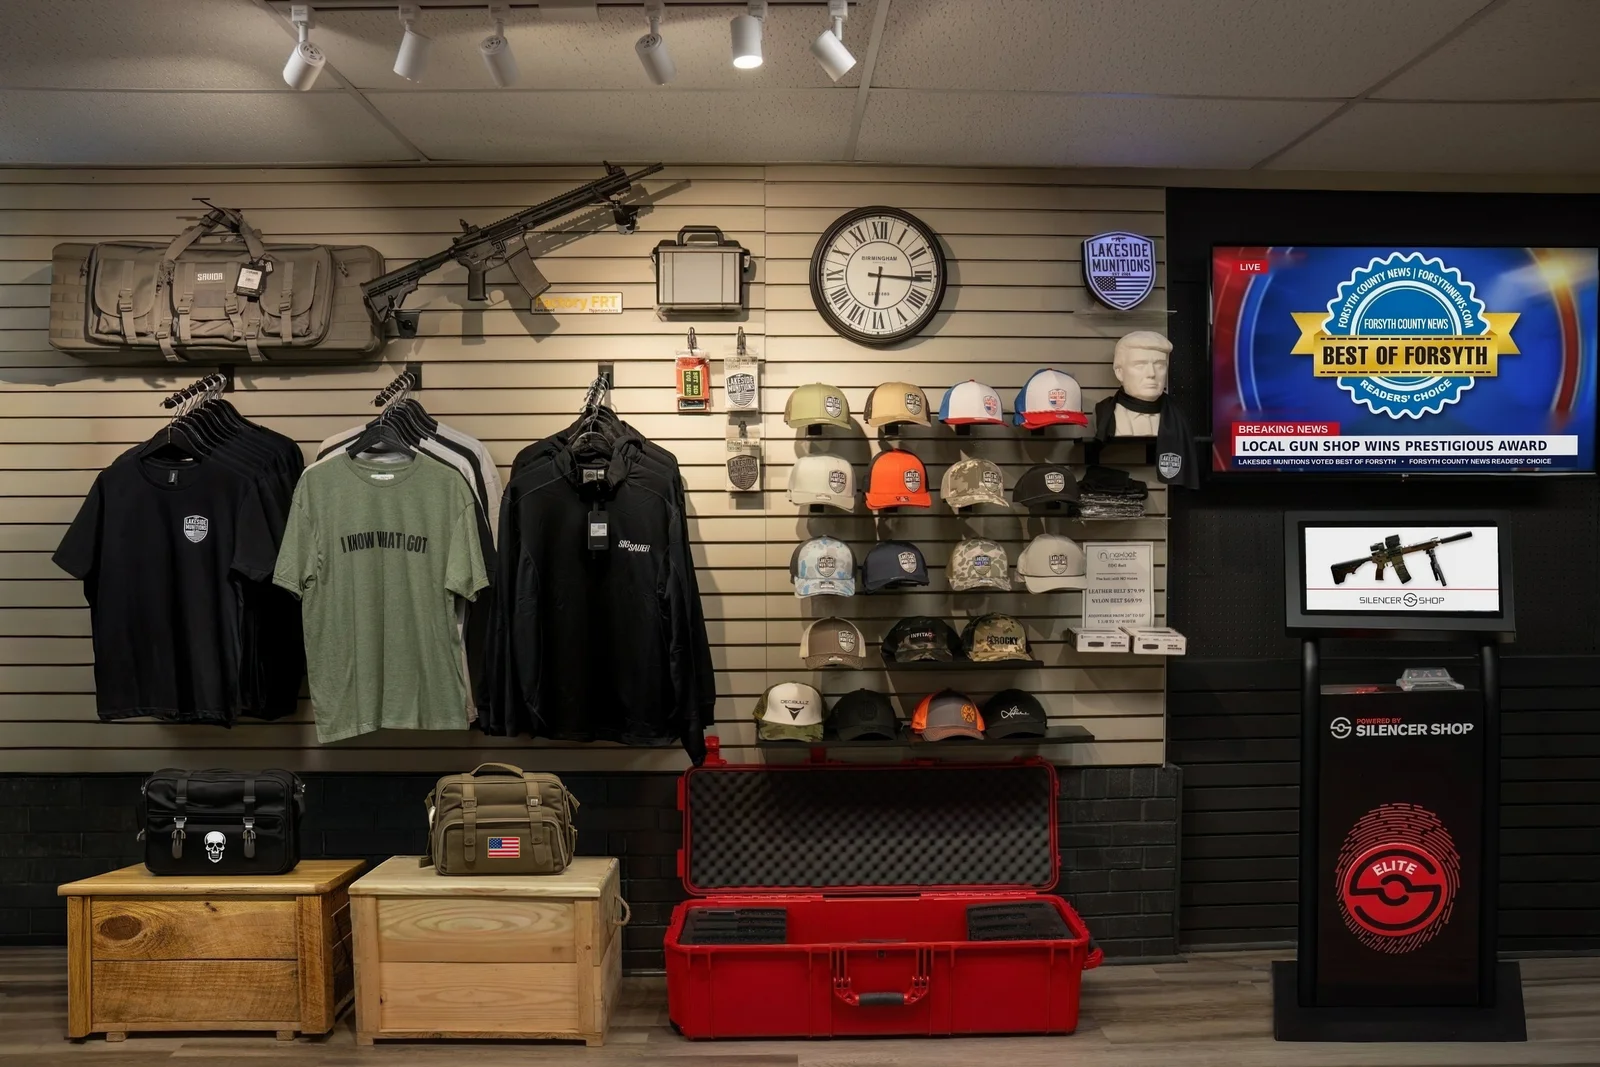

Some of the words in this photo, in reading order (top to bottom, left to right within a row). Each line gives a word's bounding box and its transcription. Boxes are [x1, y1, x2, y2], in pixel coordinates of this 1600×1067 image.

[1091, 243, 1149, 257] LAKESIDE
[1092, 259, 1151, 272] MUNITIONS
[1240, 263, 1261, 271] LIVE
[535, 295, 589, 311] Factory
[591, 295, 618, 308] FRT
[1338, 292, 1360, 329] FORSYTH
[1357, 271, 1386, 295] COUNTY
[1387, 267, 1411, 279] NEWS
[1418, 269, 1474, 329] FORSYTHNEWS.COM
[1364, 318, 1397, 330] FORSYTH
[1397, 318, 1426, 330] COUNTY
[1427, 318, 1449, 330] NEWS
[1323, 346, 1369, 365] BEST
[1376, 346, 1398, 365] OF
[1404, 346, 1488, 365] FORSYTH
[727, 375, 754, 385] LAKESIDE
[728, 383, 754, 394] MUNITIONS
[1359, 379, 1411, 403] READERS'
[1413, 378, 1452, 402] CHOICE
[1238, 425, 1294, 433] BREAKING
[1297, 425, 1328, 433] NEWS
[1242, 440, 1285, 452] LOCAL
[1289, 440, 1318, 452] GUN
[1323, 440, 1360, 452] SHOP
[1365, 440, 1400, 452] WINS
[1405, 440, 1494, 452] PRESTIGIOUS
[1498, 440, 1547, 452] AWARD
[340, 536, 347, 554] I
[347, 531, 374, 552] KNOW
[406, 534, 428, 554] GOT
[618, 539, 631, 548] SIG
[628, 543, 651, 552] SAUER
[995, 636, 1019, 645] ROCKY
[1356, 724, 1428, 737] SILENCER
[1430, 723, 1474, 735] SHOP
[1372, 860, 1418, 876] ELITE
